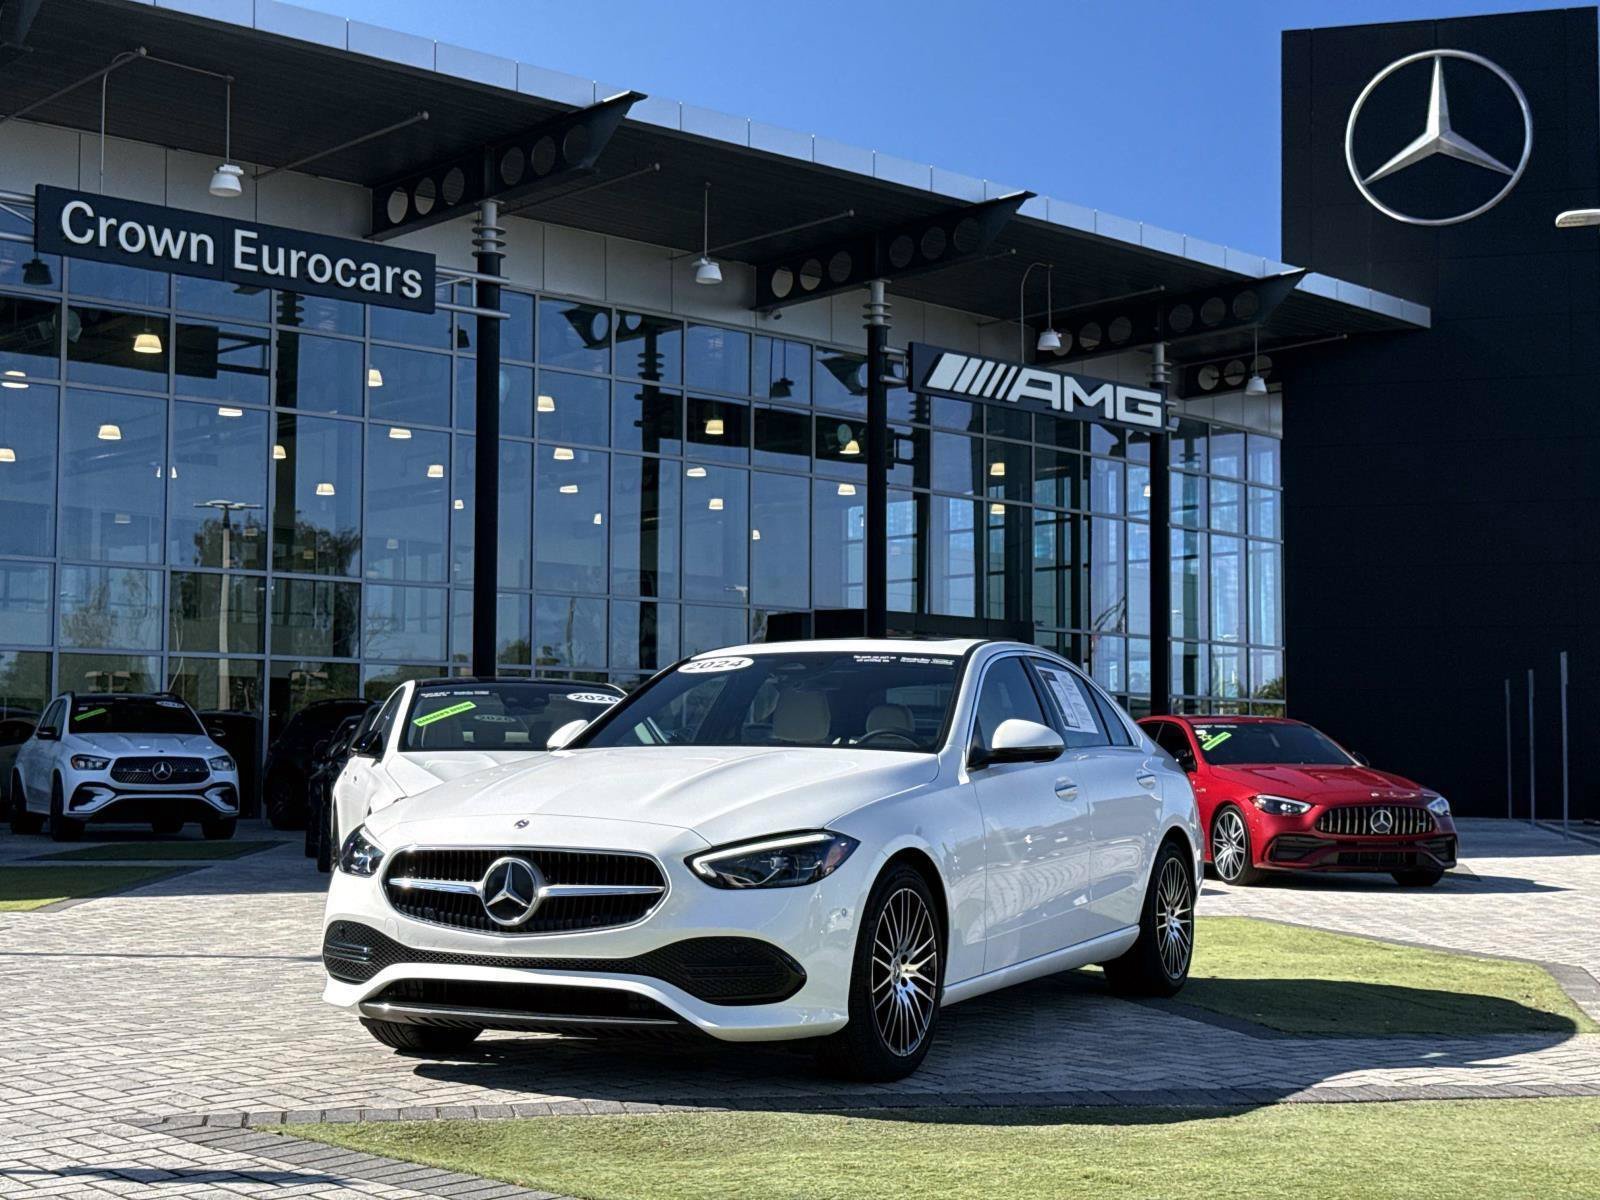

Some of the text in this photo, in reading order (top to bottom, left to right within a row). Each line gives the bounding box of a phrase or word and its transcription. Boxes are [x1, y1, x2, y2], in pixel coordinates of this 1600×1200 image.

[61, 201, 423, 299] Crown Eurocars
[1006, 367, 1162, 428] AMG
[683, 659, 746, 671] 2024
